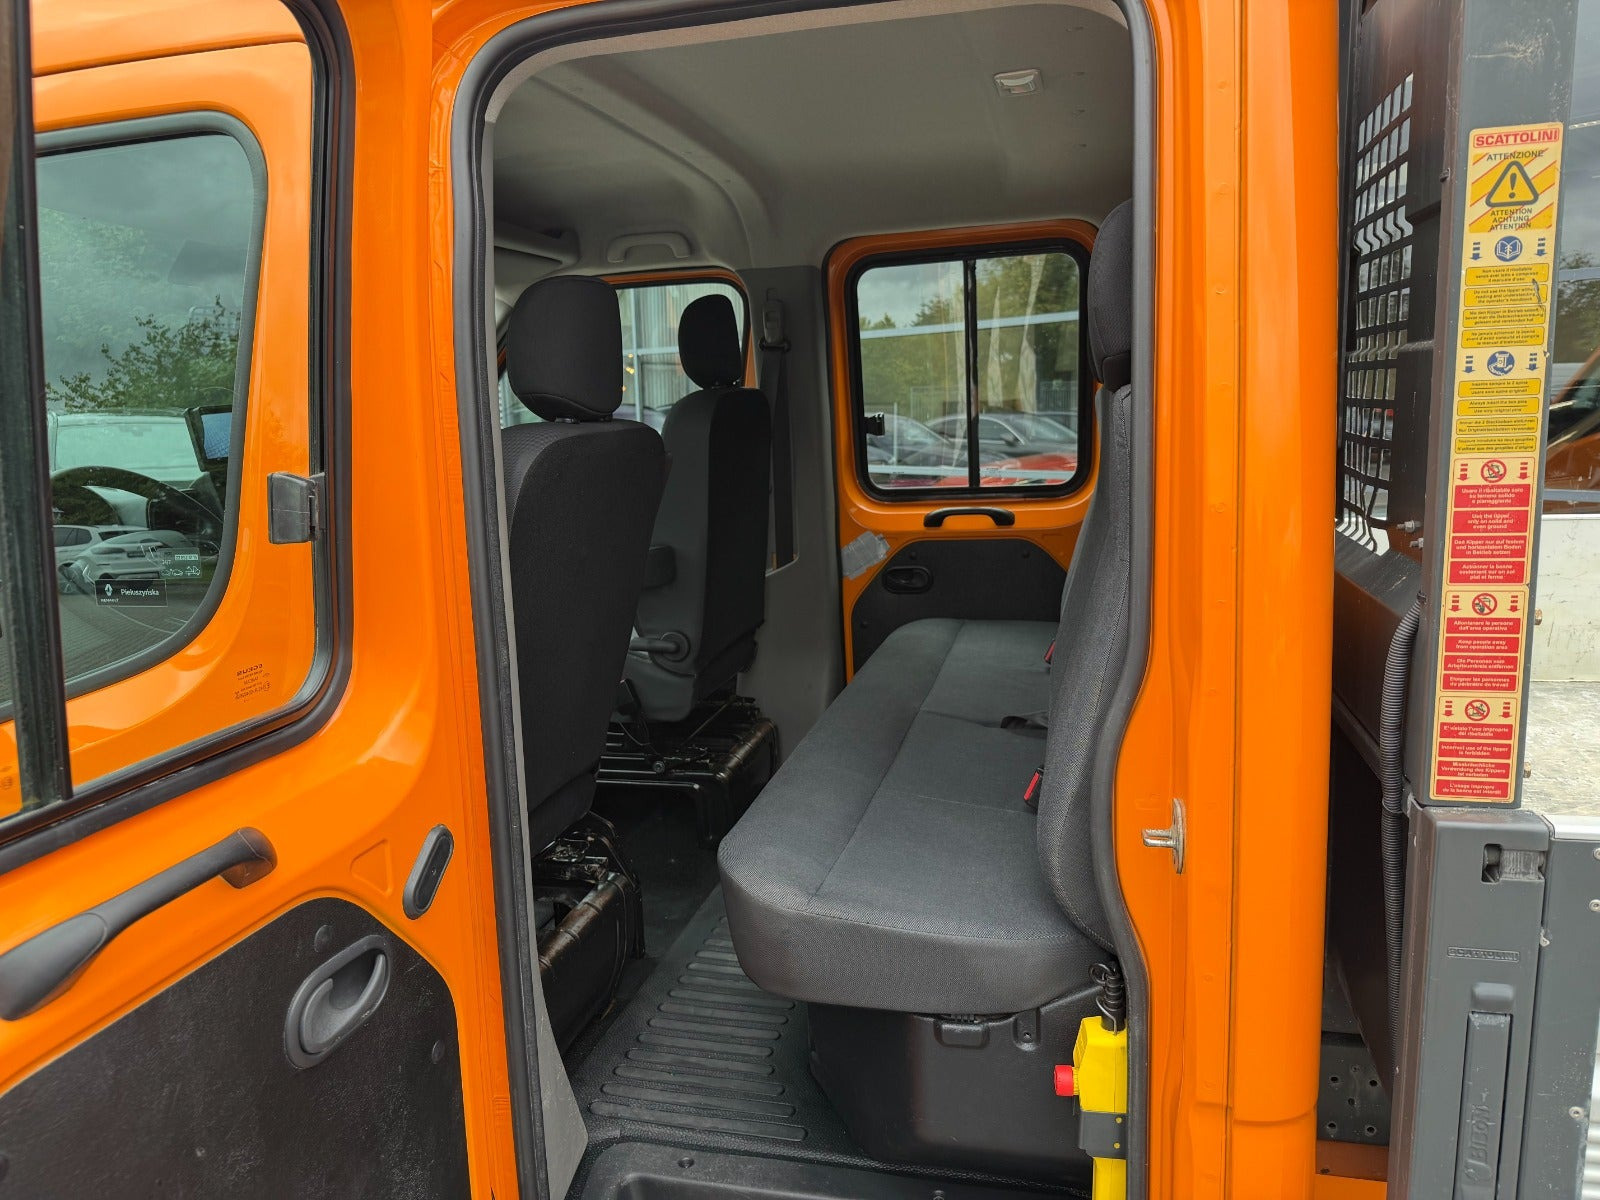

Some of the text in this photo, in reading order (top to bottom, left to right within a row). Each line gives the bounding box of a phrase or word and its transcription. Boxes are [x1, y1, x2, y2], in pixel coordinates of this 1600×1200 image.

[1476, 130, 1557, 146] SCATTOLINI
[1487, 150, 1544, 161] ATTENZIONE
[1491, 208, 1532, 216] ATTENTION
[1493, 215, 1529, 223] ACHTUNG
[1490, 222, 1531, 231] ATTENTION
